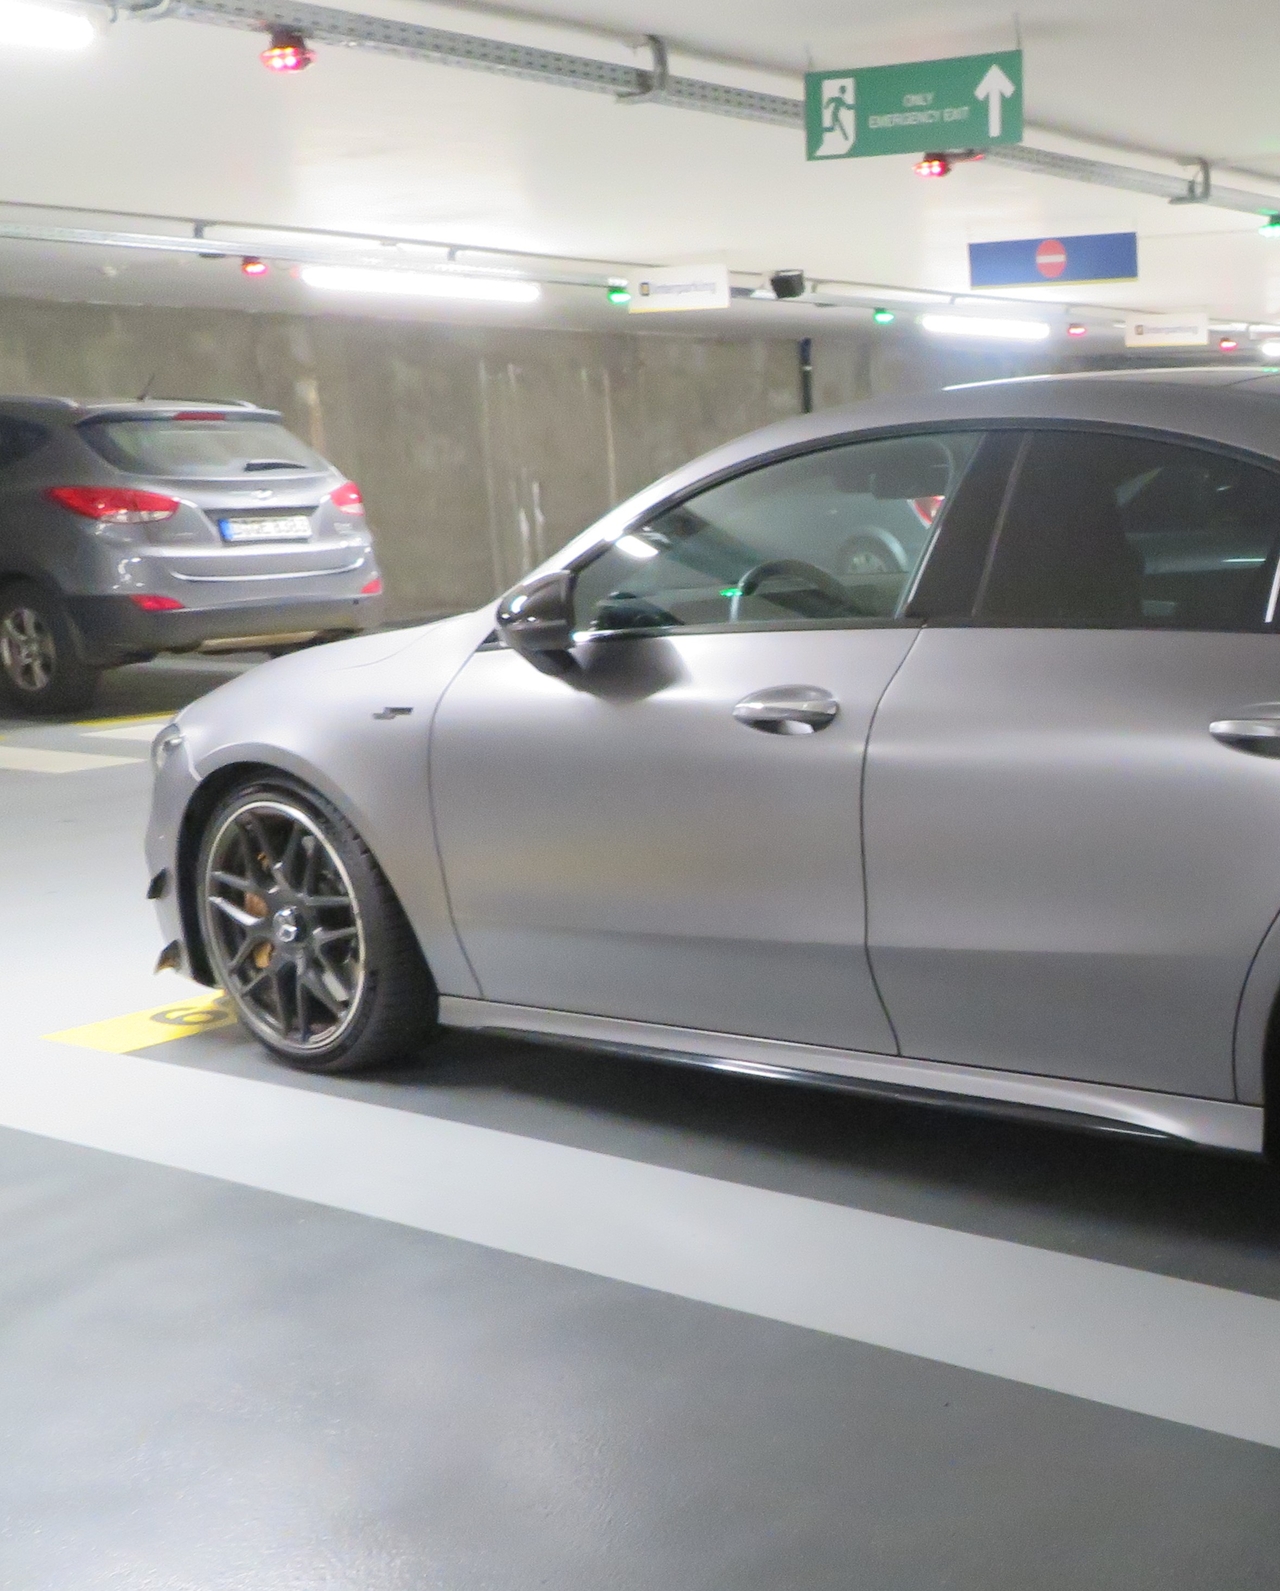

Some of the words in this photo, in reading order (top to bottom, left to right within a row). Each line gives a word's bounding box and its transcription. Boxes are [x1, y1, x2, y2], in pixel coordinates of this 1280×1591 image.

[903, 93, 934, 107] ONLY
[868, 110, 941, 128] EMERGENCY
[943, 106, 969, 122] EXIT
